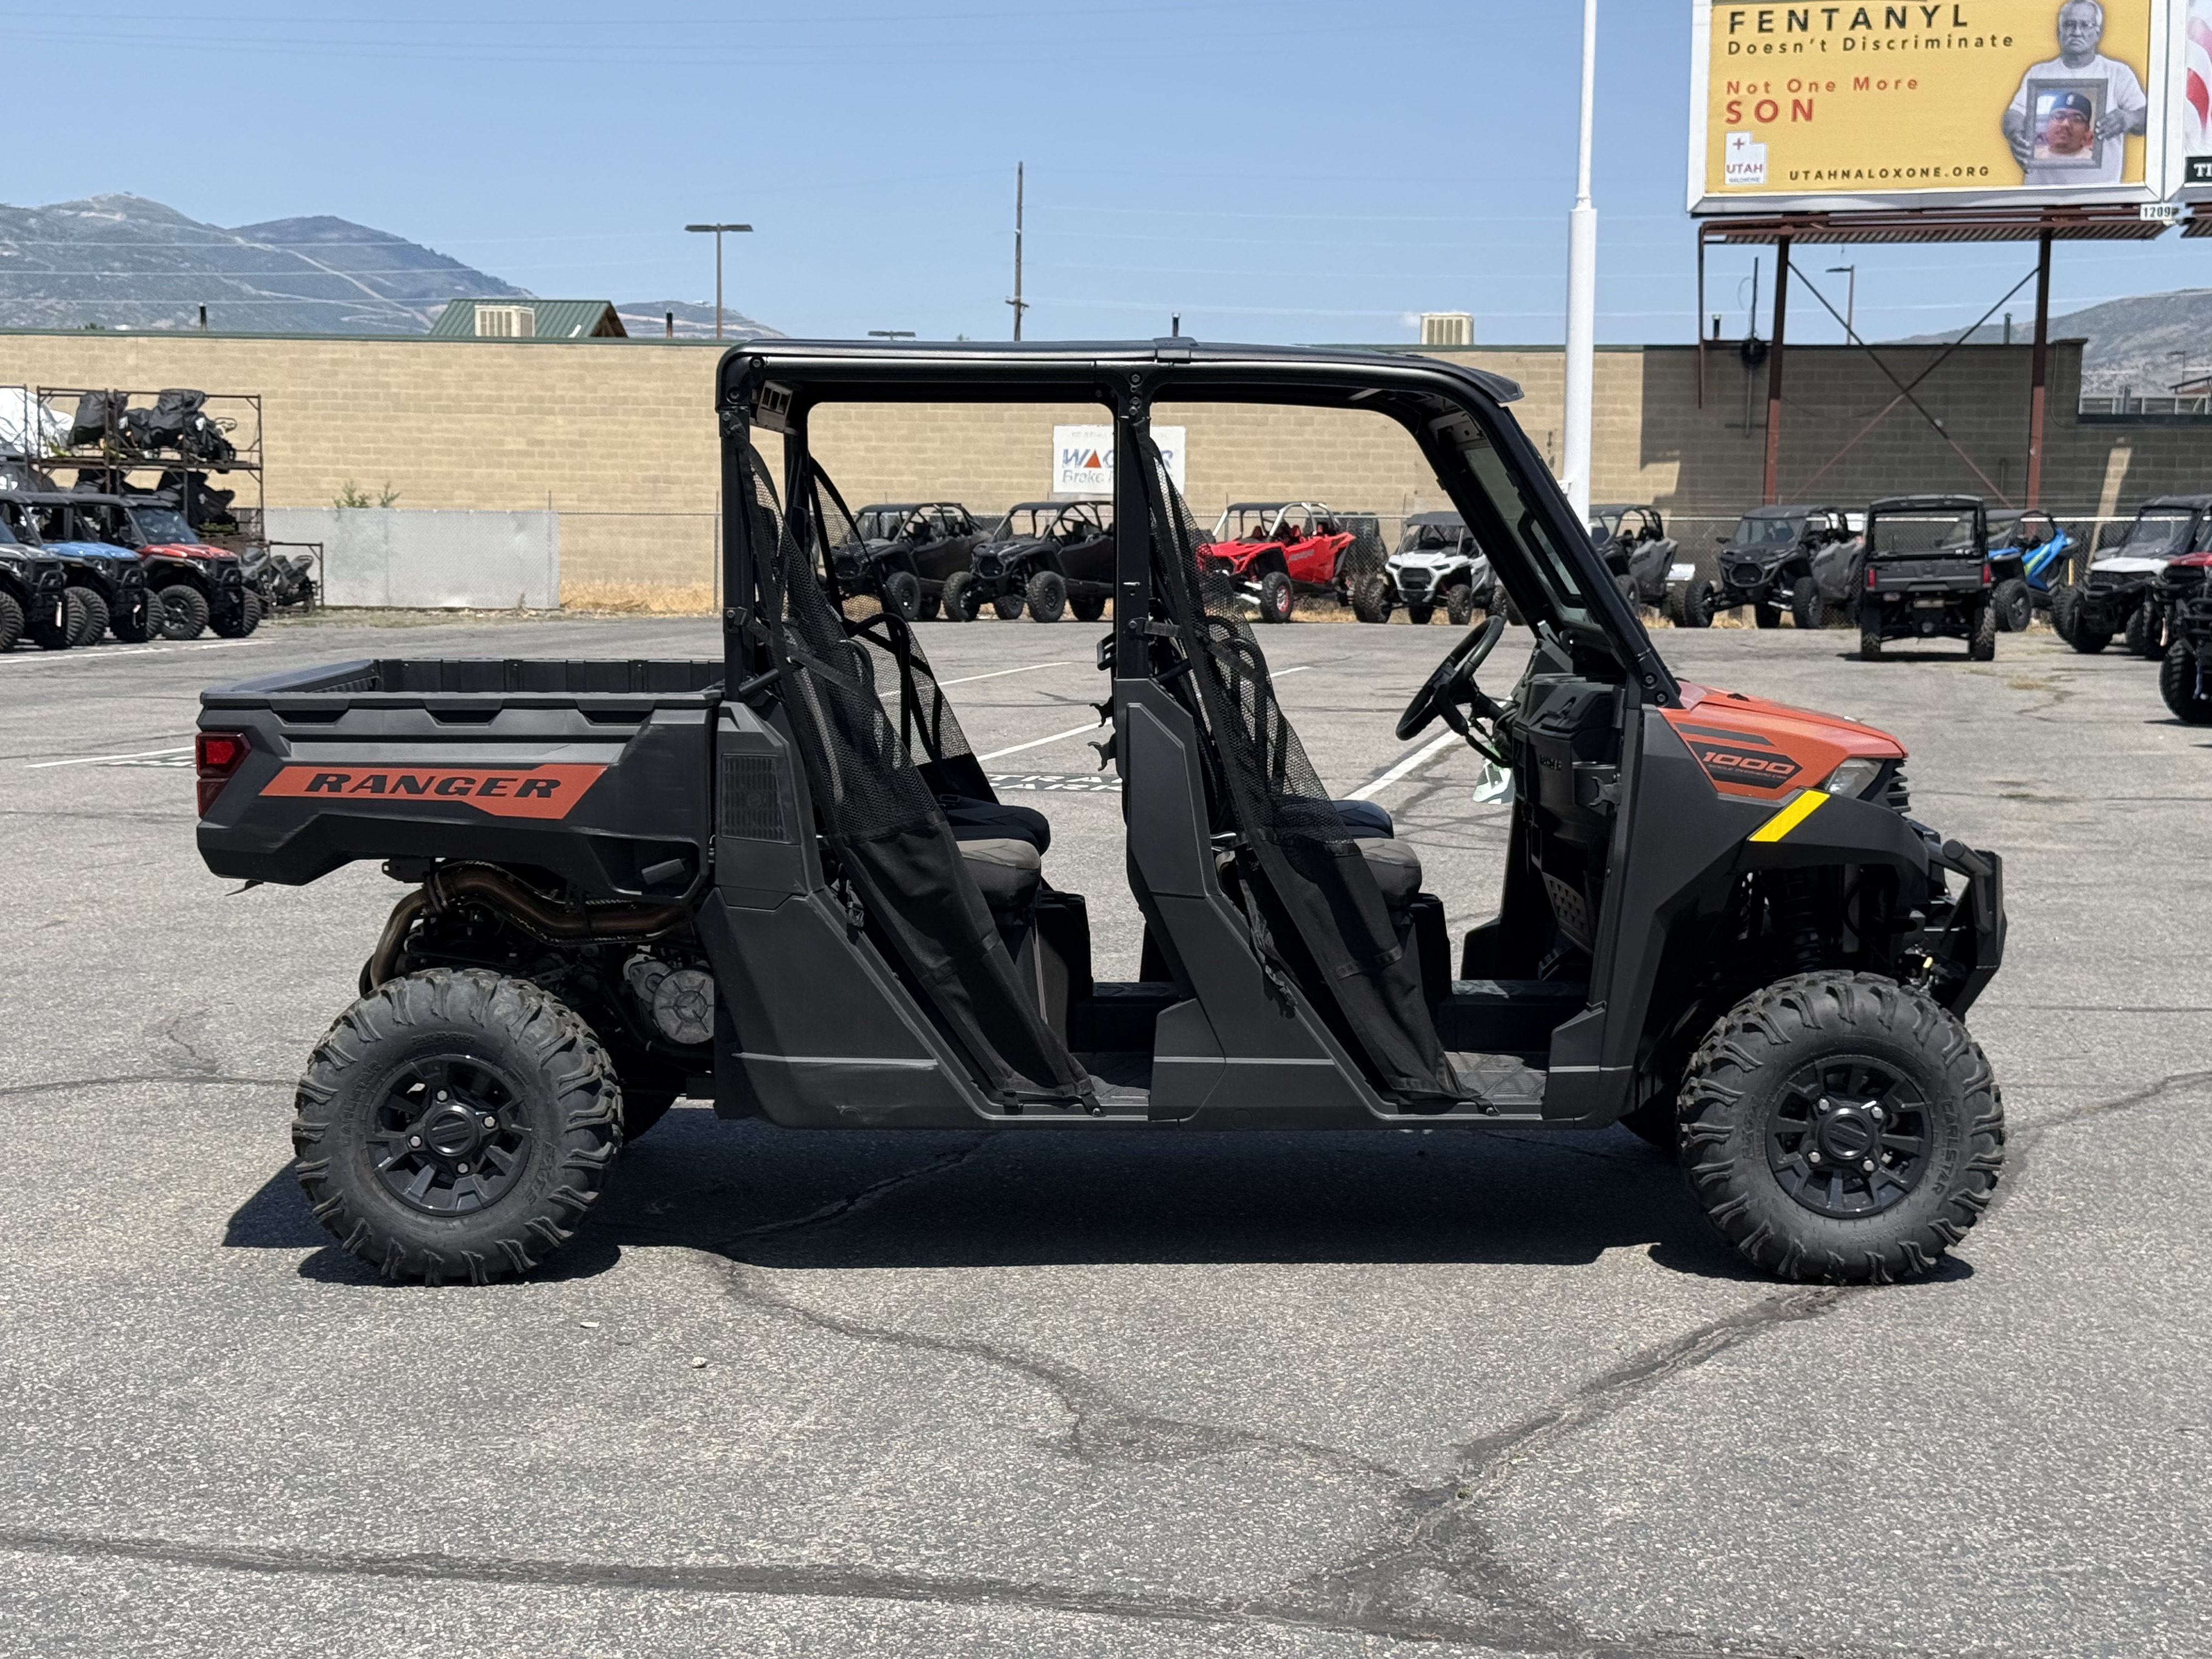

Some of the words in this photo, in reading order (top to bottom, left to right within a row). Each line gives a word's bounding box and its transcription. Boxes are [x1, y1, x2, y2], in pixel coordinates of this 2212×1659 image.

[1729, 4, 1968, 35] FENTANYL
[1728, 38, 1827, 55] Doesn't
[1842, 34, 2013, 52] Discriminate
[1726, 80, 1771, 95] Not
[1786, 78, 1836, 93] One
[1853, 76, 1918, 92] More
[1725, 98, 1814, 125] SON
[1726, 163, 1763, 174] UTAH
[1789, 166, 1989, 181] UTAHNALOXONE.ORG
[2144, 206, 2171, 218] 1209
[1062, 469, 1104, 483] Brake
[1703, 752, 1796, 775] 1000
[304, 773, 562, 798] RANGER
[1931, 1100, 1959, 1196] CARLSTAR
